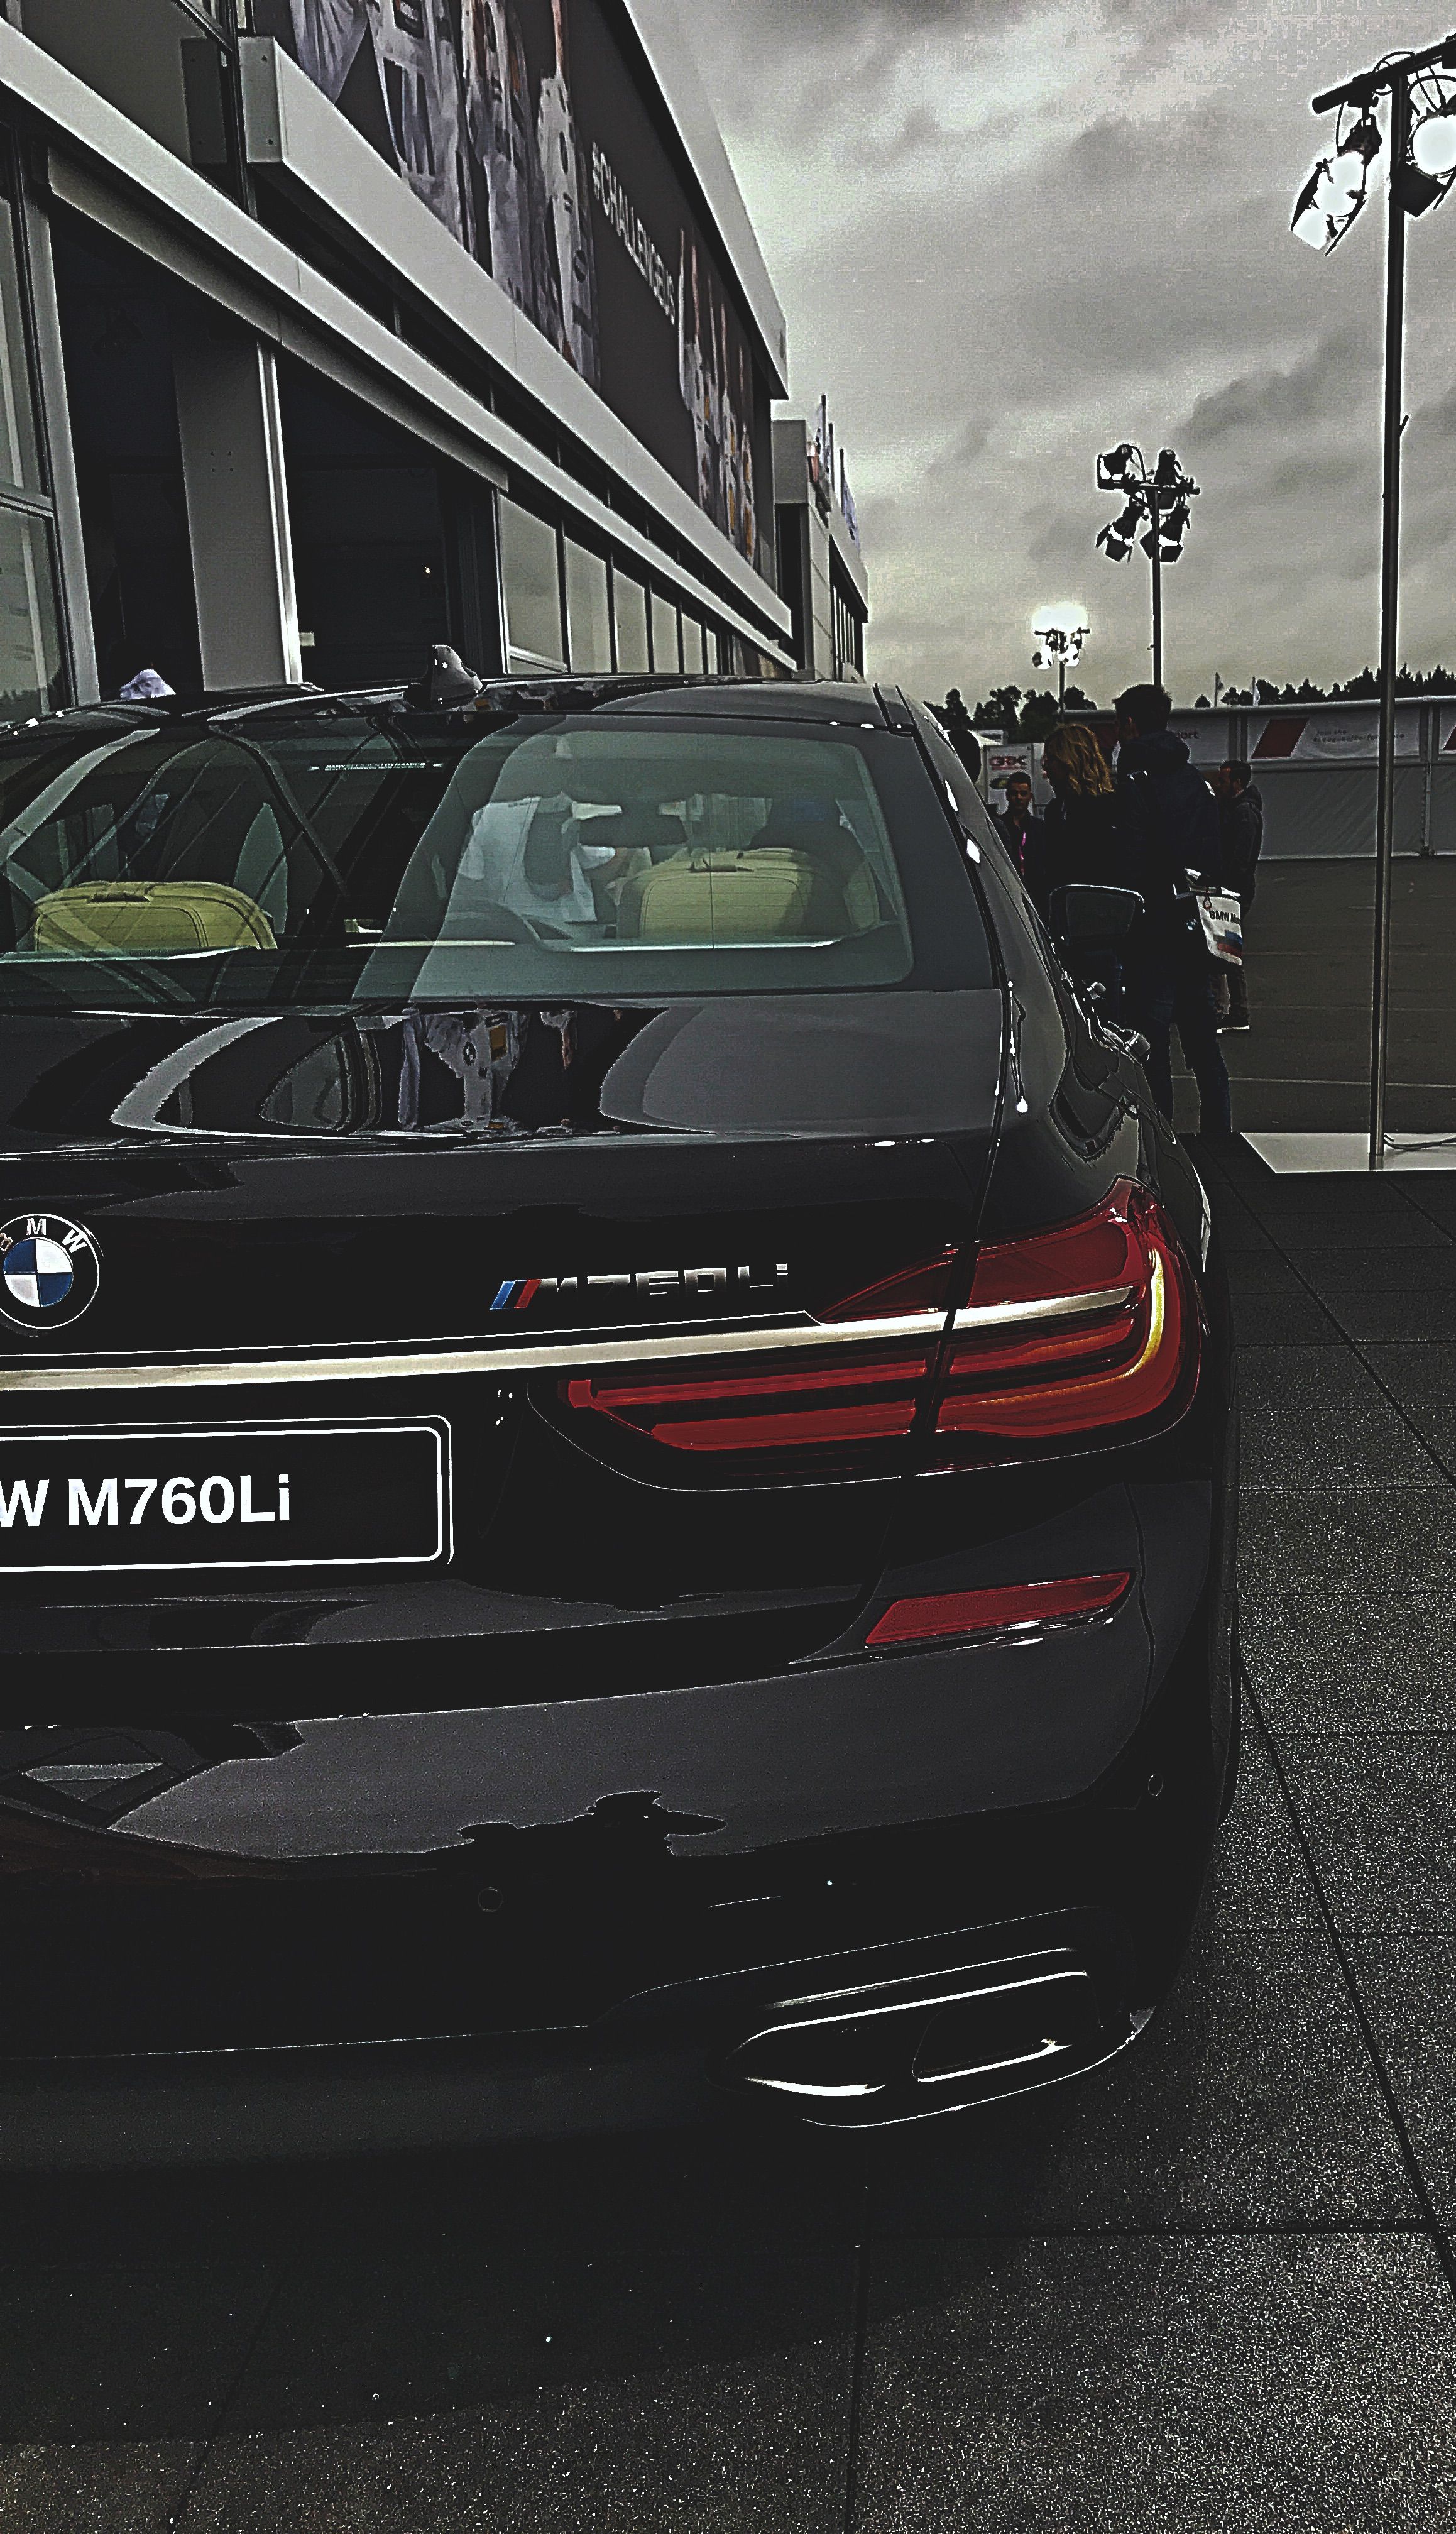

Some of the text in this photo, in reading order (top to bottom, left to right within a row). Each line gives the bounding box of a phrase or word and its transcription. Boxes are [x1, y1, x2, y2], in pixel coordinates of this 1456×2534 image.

[1209, 910, 1230, 922] BMW
[0, 1217, 87, 1254] BMW
[68, 1474, 290, 1526] M760Li
